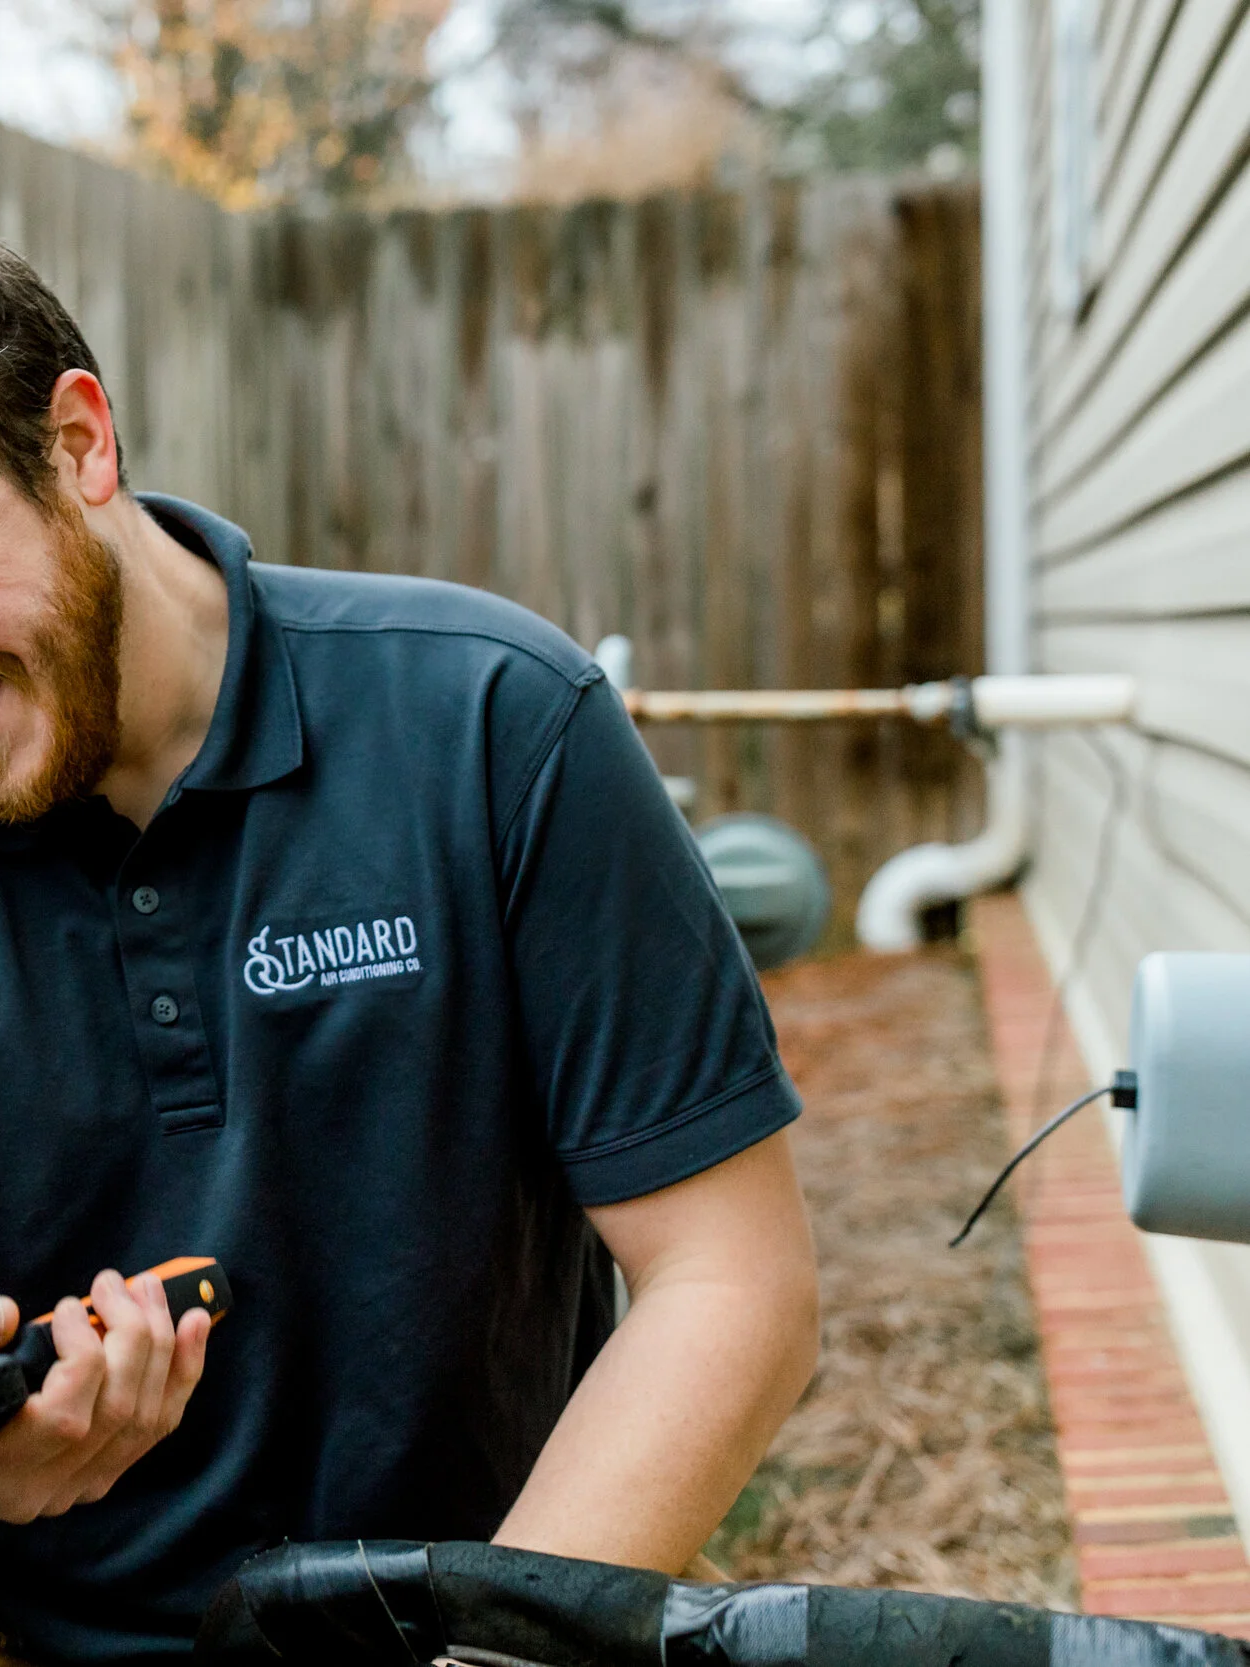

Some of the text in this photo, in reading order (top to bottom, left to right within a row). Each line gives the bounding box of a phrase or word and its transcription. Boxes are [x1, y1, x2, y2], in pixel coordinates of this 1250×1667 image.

[244, 916, 417, 995] STANDARD
[320, 971, 338, 987] AIR
[338, 959, 404, 982] CONDITIONING
